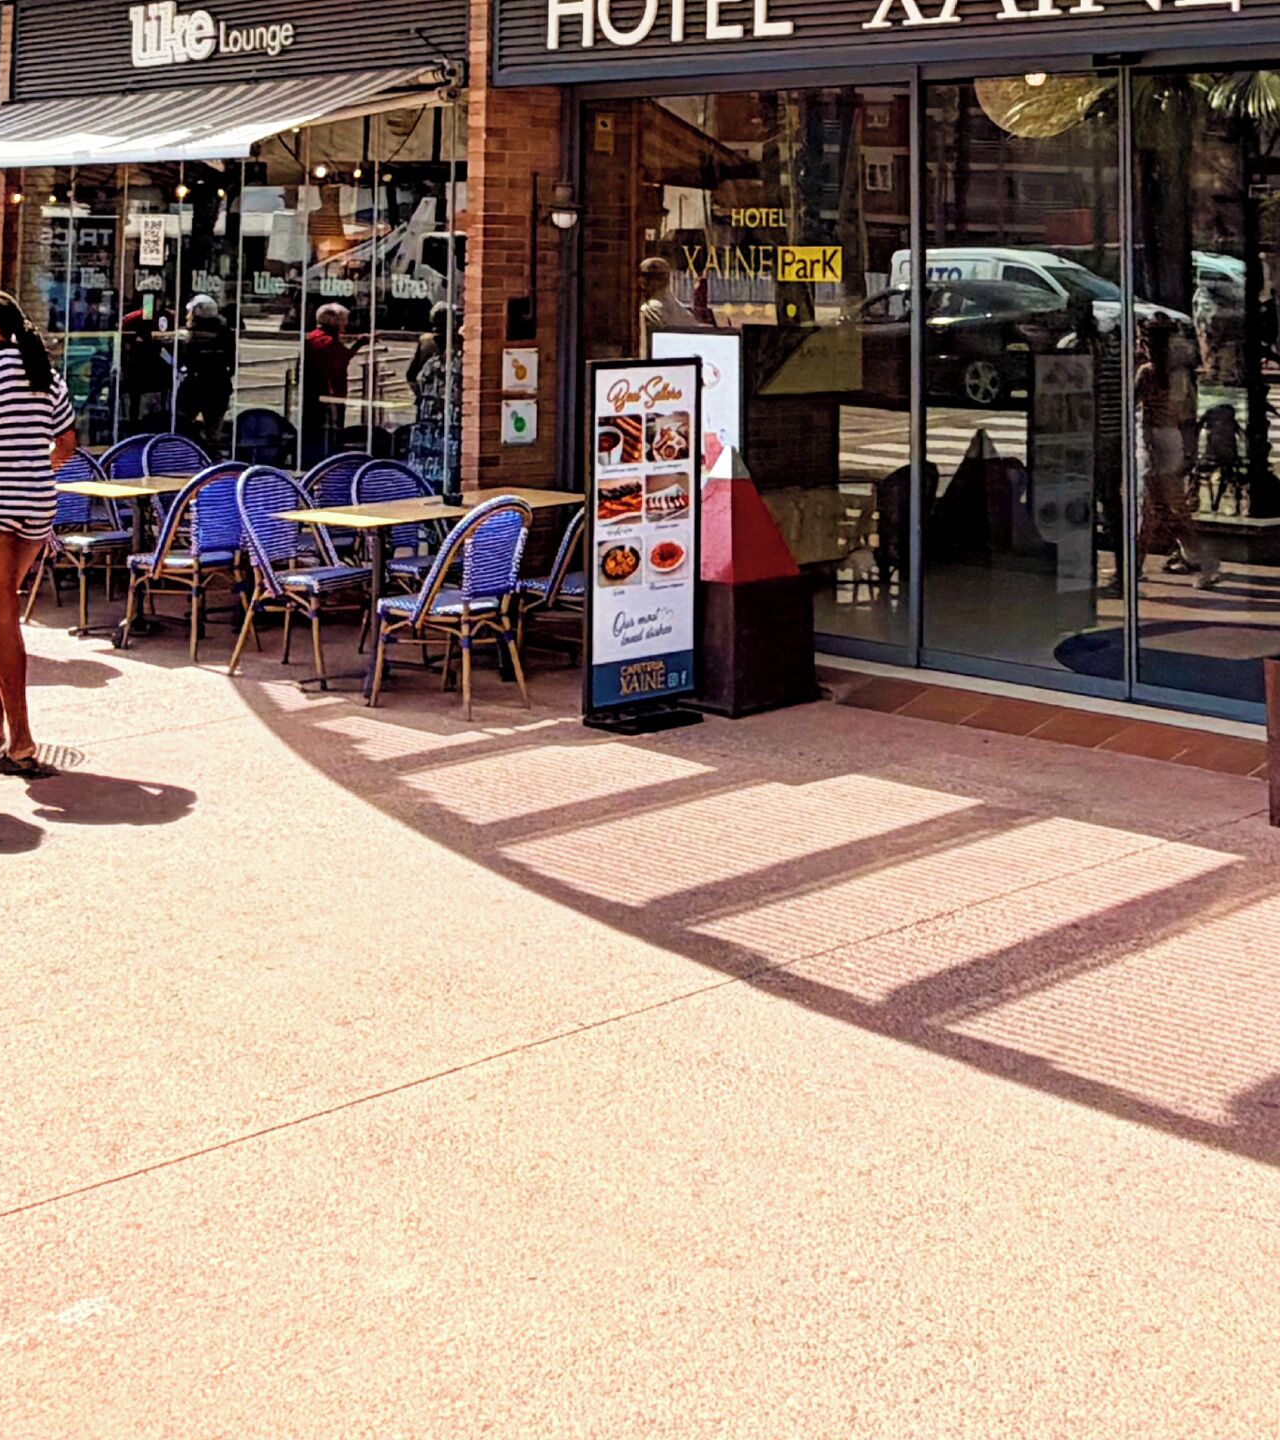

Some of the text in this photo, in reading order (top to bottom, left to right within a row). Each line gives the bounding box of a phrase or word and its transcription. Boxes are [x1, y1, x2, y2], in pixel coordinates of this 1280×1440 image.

[220, 22, 294, 56] Lounge
[731, 208, 788, 227] HOTEL
[681, 245, 839, 280] XAINE ParK
[620, 672, 666, 697] XAINE
